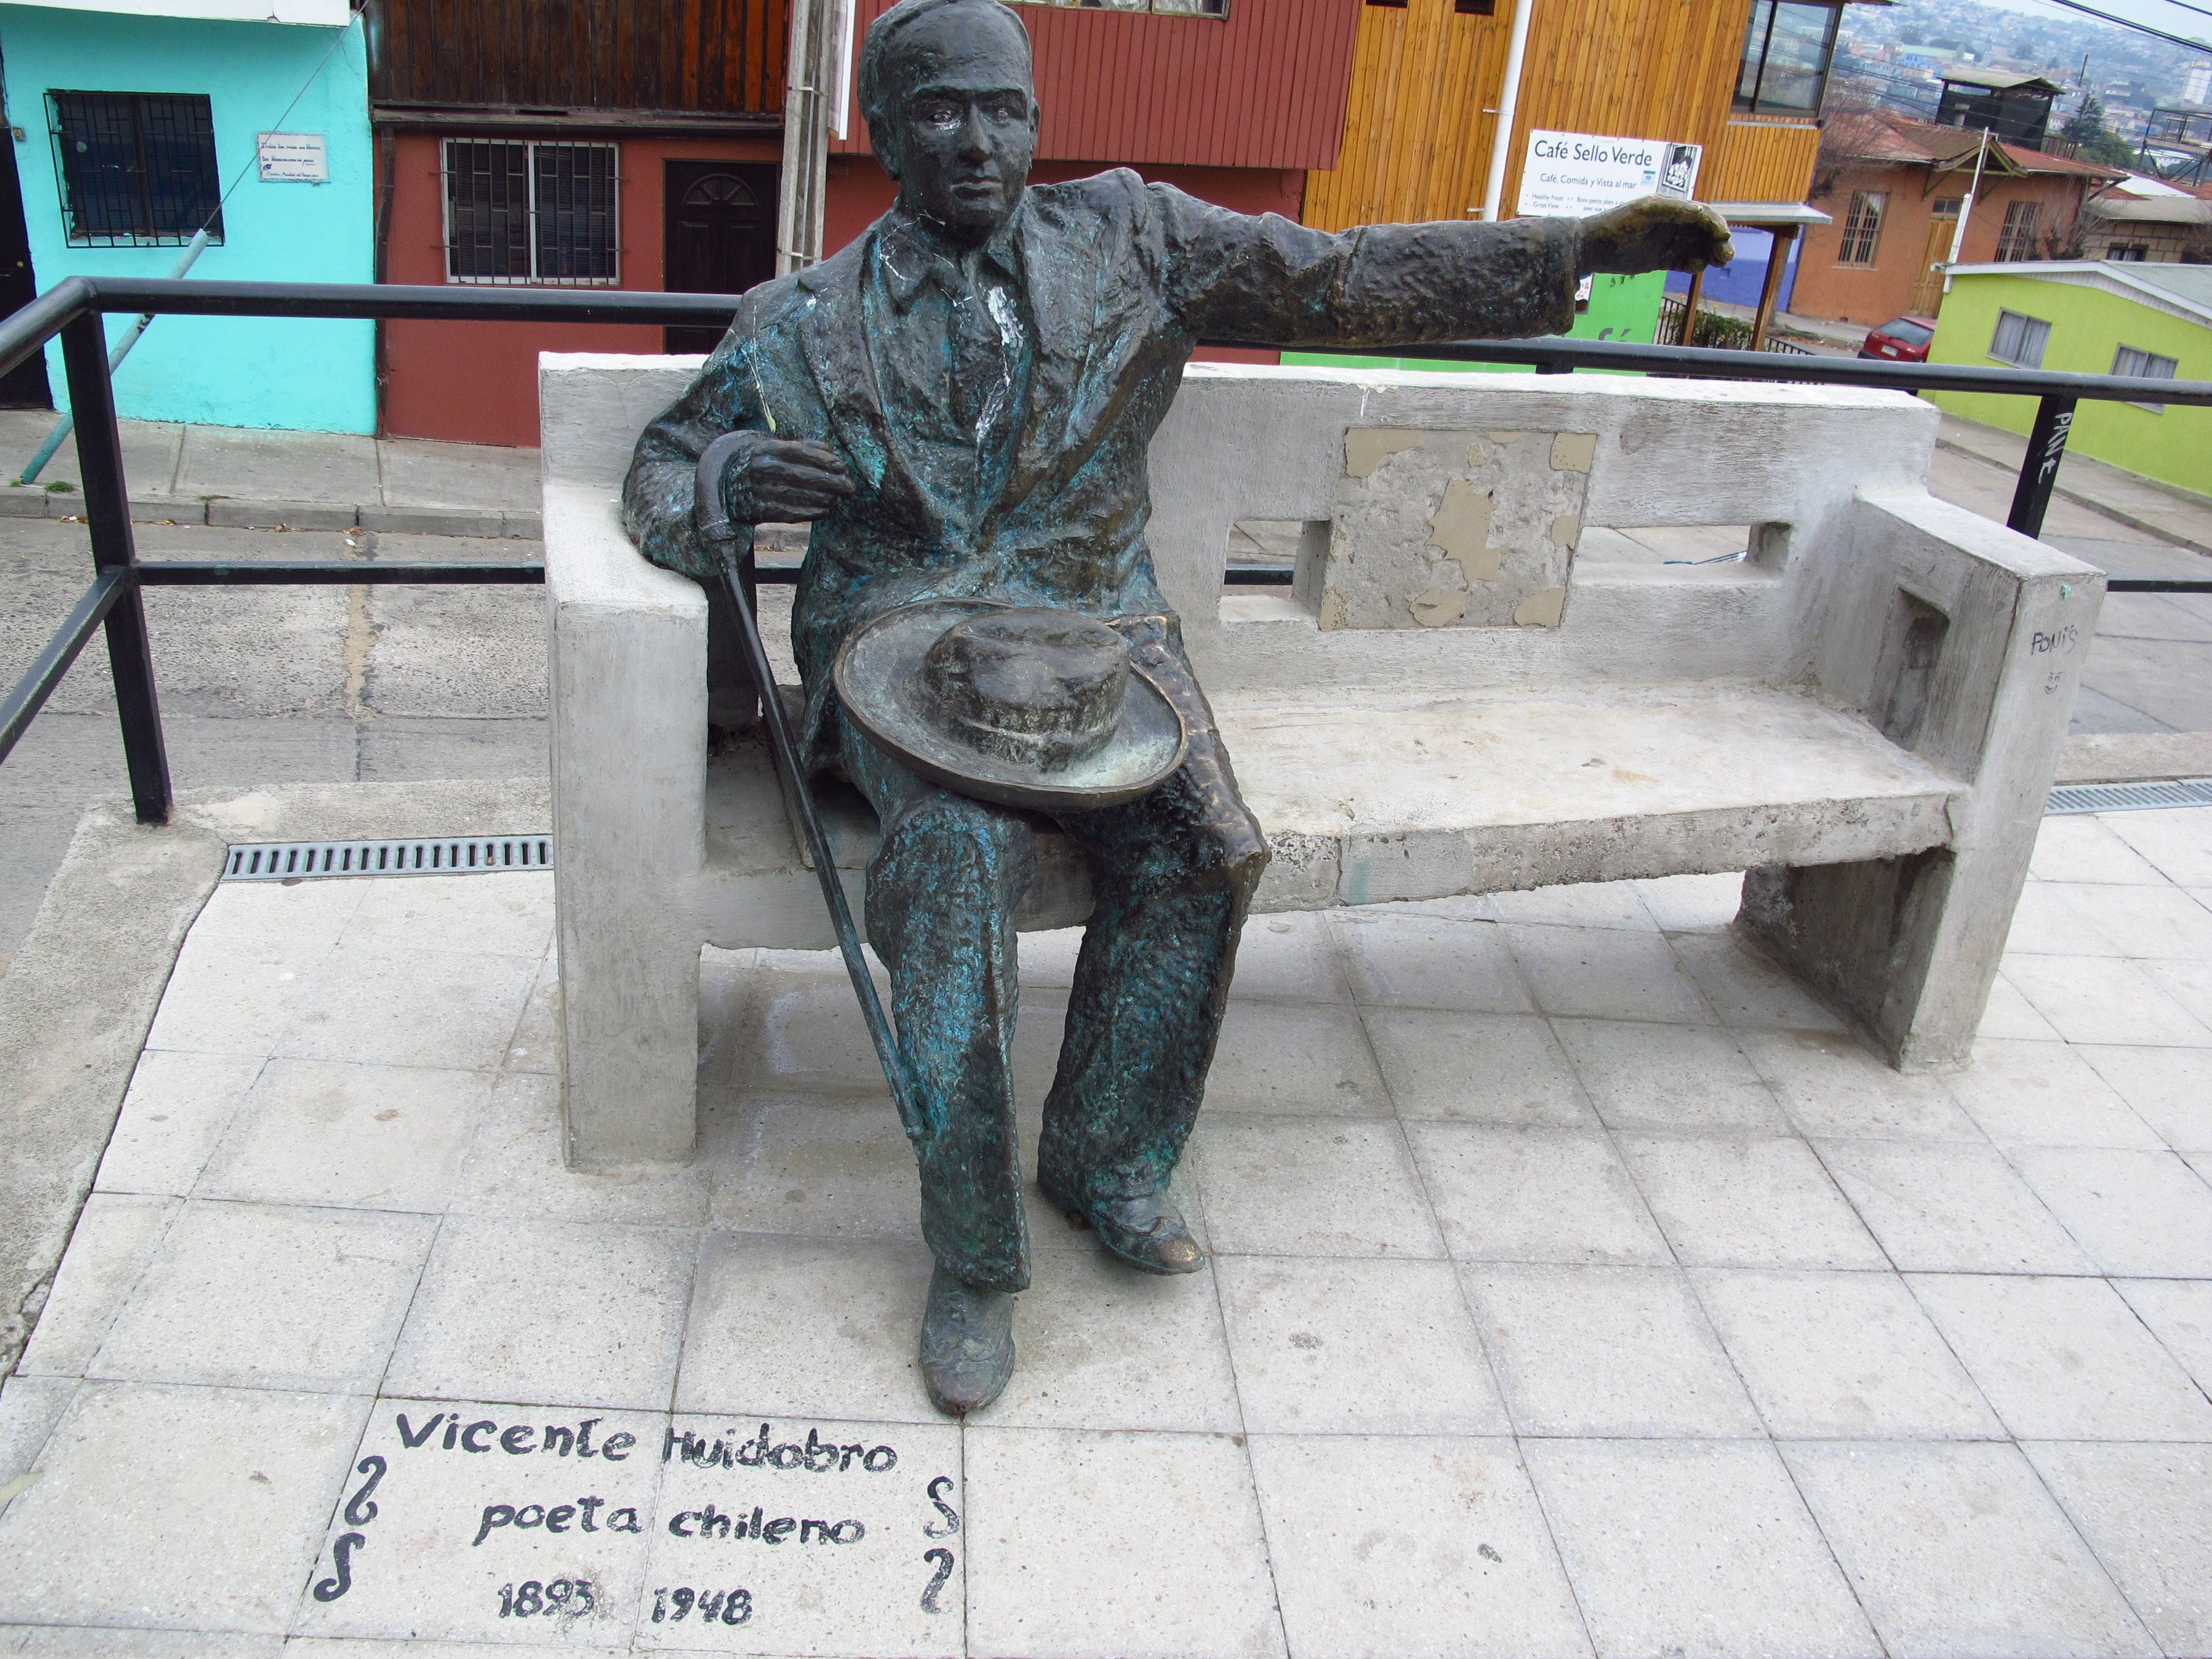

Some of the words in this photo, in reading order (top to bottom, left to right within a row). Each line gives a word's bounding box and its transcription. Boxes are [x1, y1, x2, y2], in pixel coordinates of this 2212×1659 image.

[1534, 140, 1568, 159] Café
[1573, 143, 1607, 163] Sello
[1612, 146, 1652, 166] Verde
[1540, 173, 1558, 184] Café,
[1560, 175, 1589, 186] Comida
[1590, 179, 1595, 188] y
[1597, 178, 1614, 187] Vista
[1615, 179, 1621, 188] al
[397, 1413, 637, 1461] Vicente
[662, 1423, 898, 1473] Huidobro
[471, 1494, 645, 1547] poeta
[668, 1504, 866, 1545] chileno
[497, 1578, 594, 1619] 1893
[651, 1586, 752, 1626] 1948
